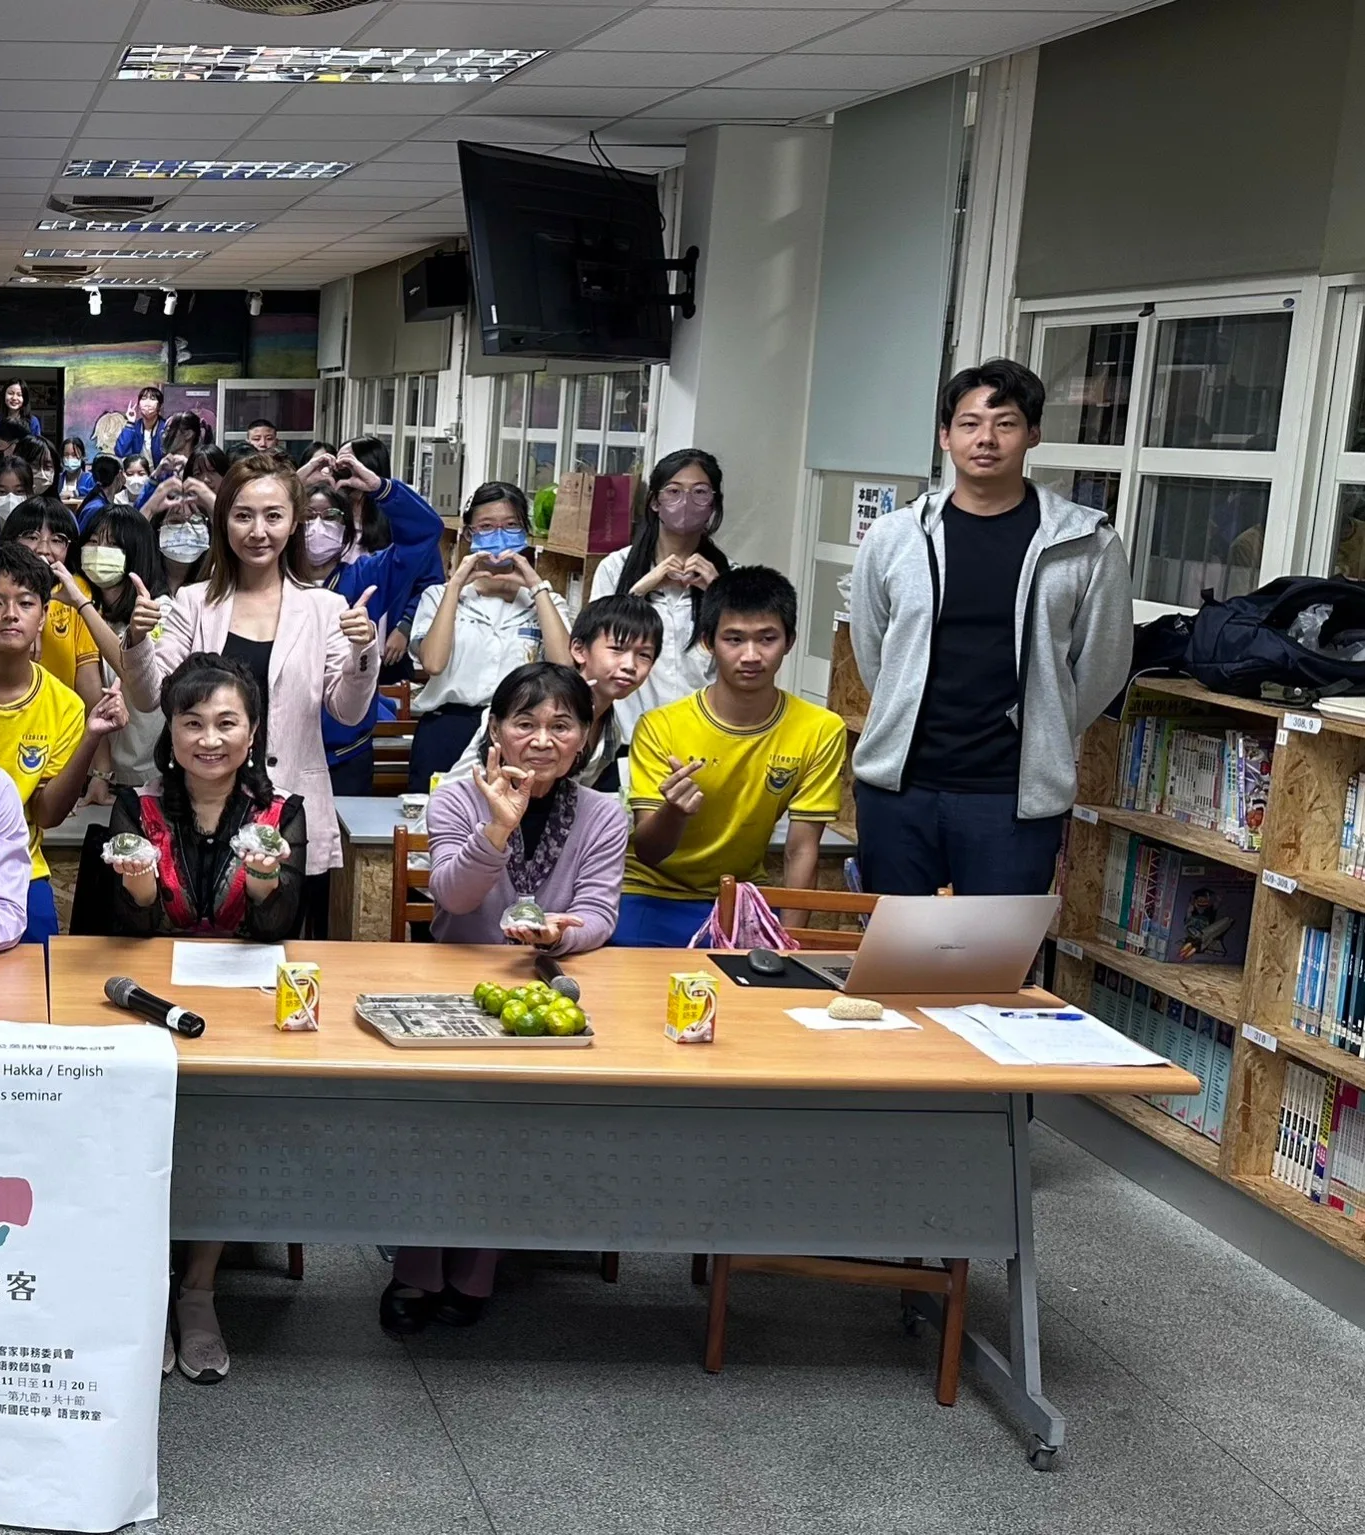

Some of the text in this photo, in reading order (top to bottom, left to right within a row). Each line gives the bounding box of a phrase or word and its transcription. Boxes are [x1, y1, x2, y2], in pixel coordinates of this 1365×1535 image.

[1292, 717, 1314, 730] 308.9
[3, 1063, 43, 1077] Hakka
[57, 1064, 103, 1080] English
[11, 1089, 63, 1102] seminar
